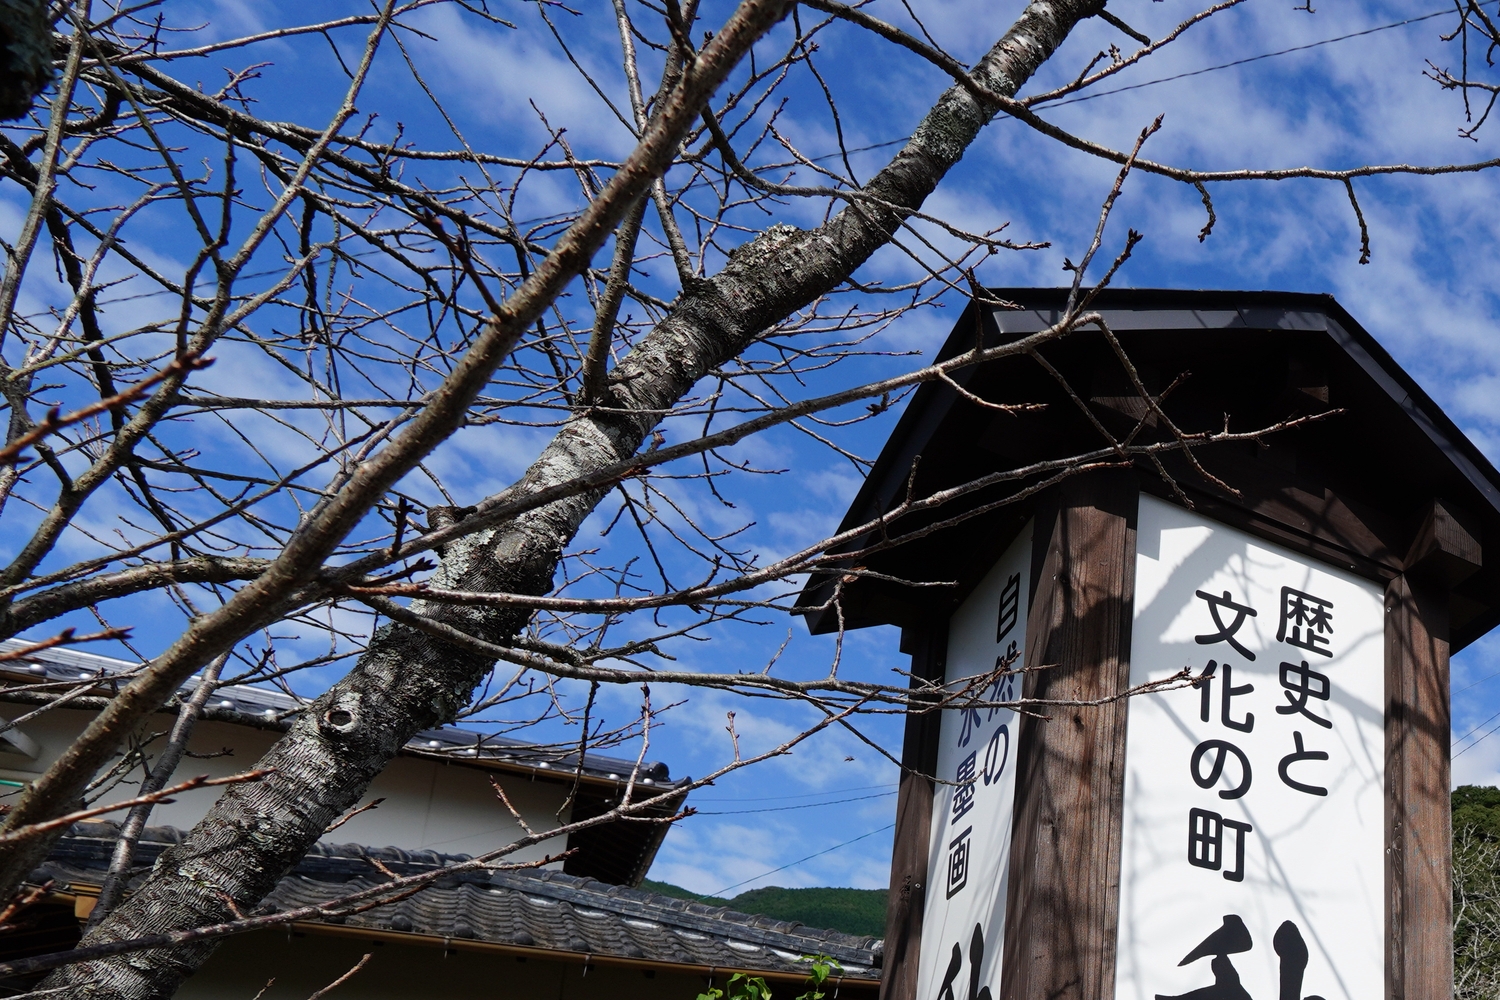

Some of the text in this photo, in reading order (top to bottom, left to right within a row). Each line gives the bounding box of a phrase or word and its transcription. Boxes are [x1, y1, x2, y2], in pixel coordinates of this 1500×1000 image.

[1187, 589, 1259, 883] 文化の町
[1275, 585, 1335, 797] 歴史と
